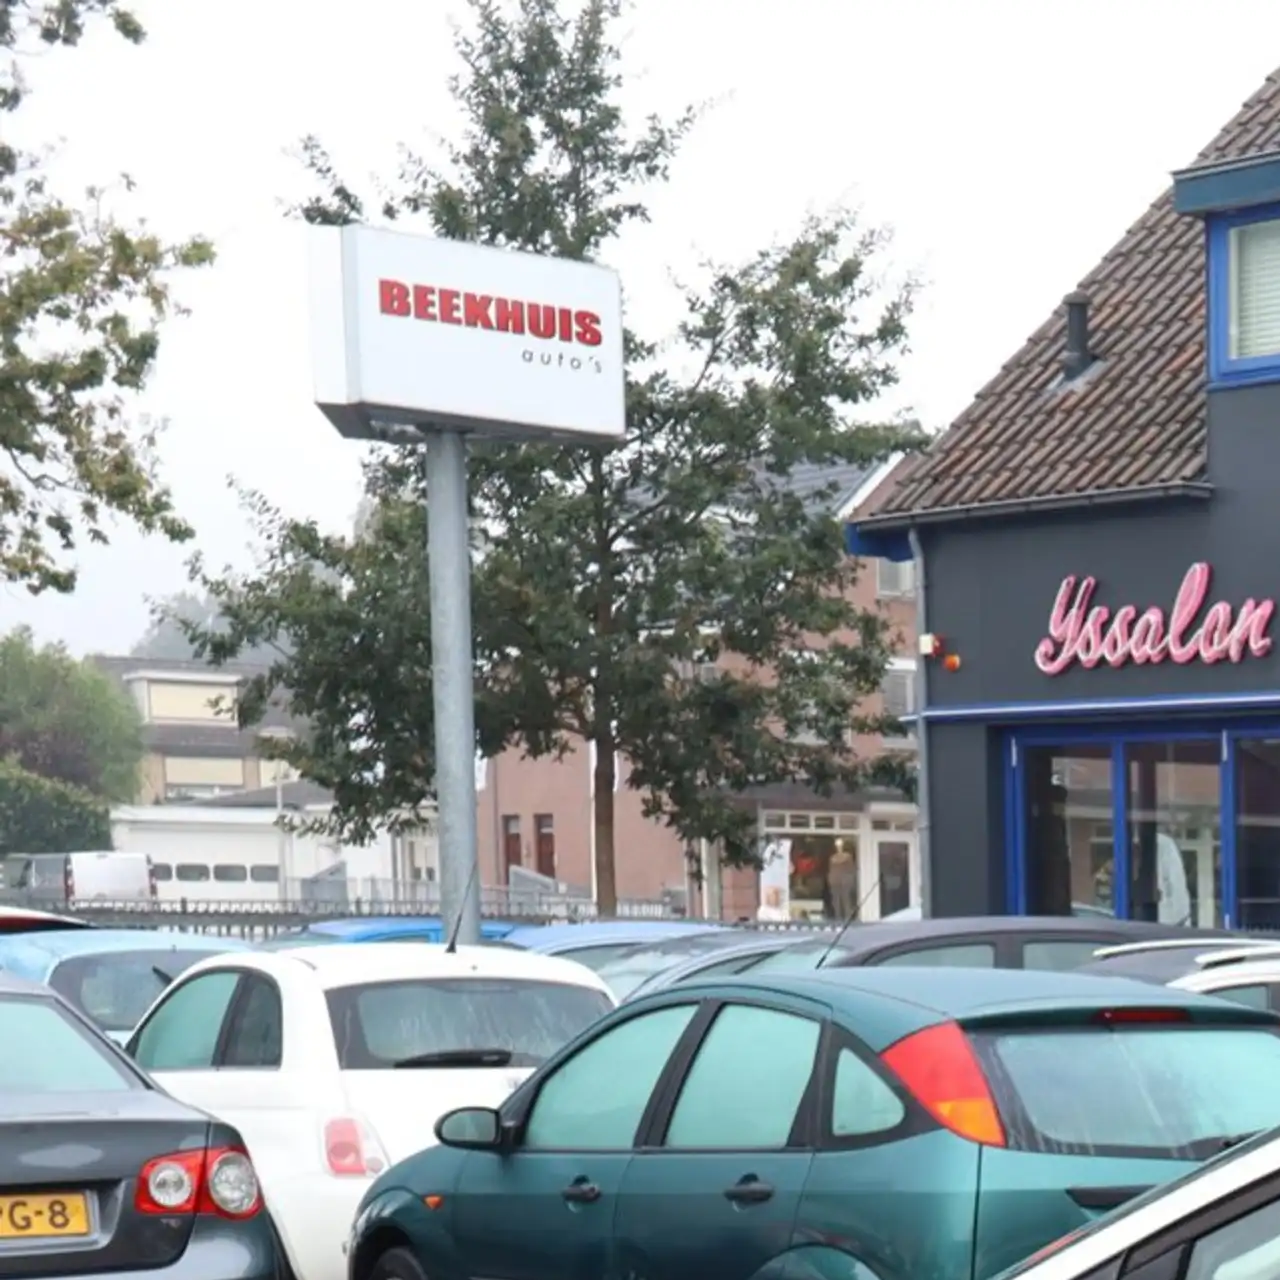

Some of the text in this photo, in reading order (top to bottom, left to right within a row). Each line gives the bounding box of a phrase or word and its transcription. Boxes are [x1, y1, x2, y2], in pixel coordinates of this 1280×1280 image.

[378, 279, 602, 347] BEEKHUIS
[522, 348, 602, 373] auto's
[1034, 562, 1276, 676] Yssalon
[0, 1200, 70, 1231] G-8
